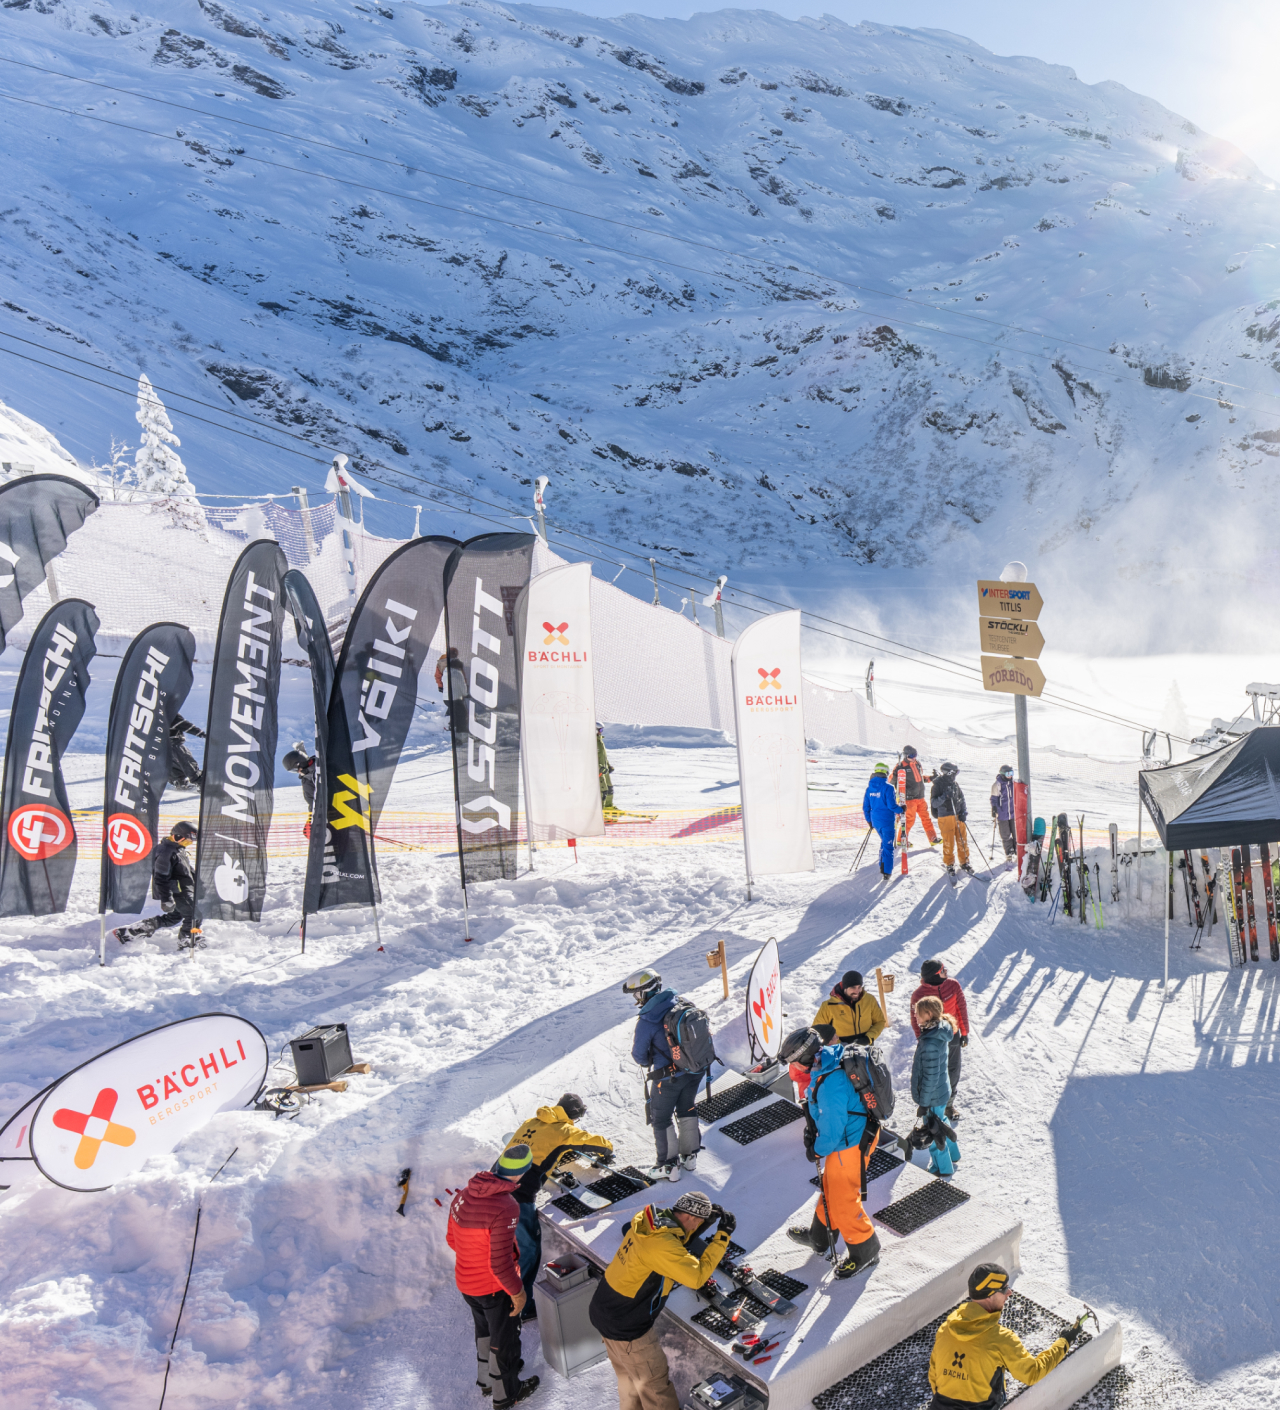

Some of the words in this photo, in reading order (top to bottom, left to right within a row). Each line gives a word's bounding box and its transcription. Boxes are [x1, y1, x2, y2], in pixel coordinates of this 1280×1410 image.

[988, 589, 1031, 600] INTERSPORT
[1000, 602, 1022, 612] TITLIS
[988, 620, 1028, 632] STÖCKLI
[988, 634, 1017, 644] TESTCENTER
[528, 651, 587, 662] BÄCHLI
[989, 669, 1034, 691] TORBIDO
[467, 577, 503, 796] SCOTT
[745, 695, 797, 706] BÄCHLI
[115, 646, 170, 809] FRITSCHI
[136, 1039, 248, 1111] BÄCHLI
[149, 1082, 220, 1126] BERGSPORT
[943, 1368, 969, 1381] BÄCHLI
